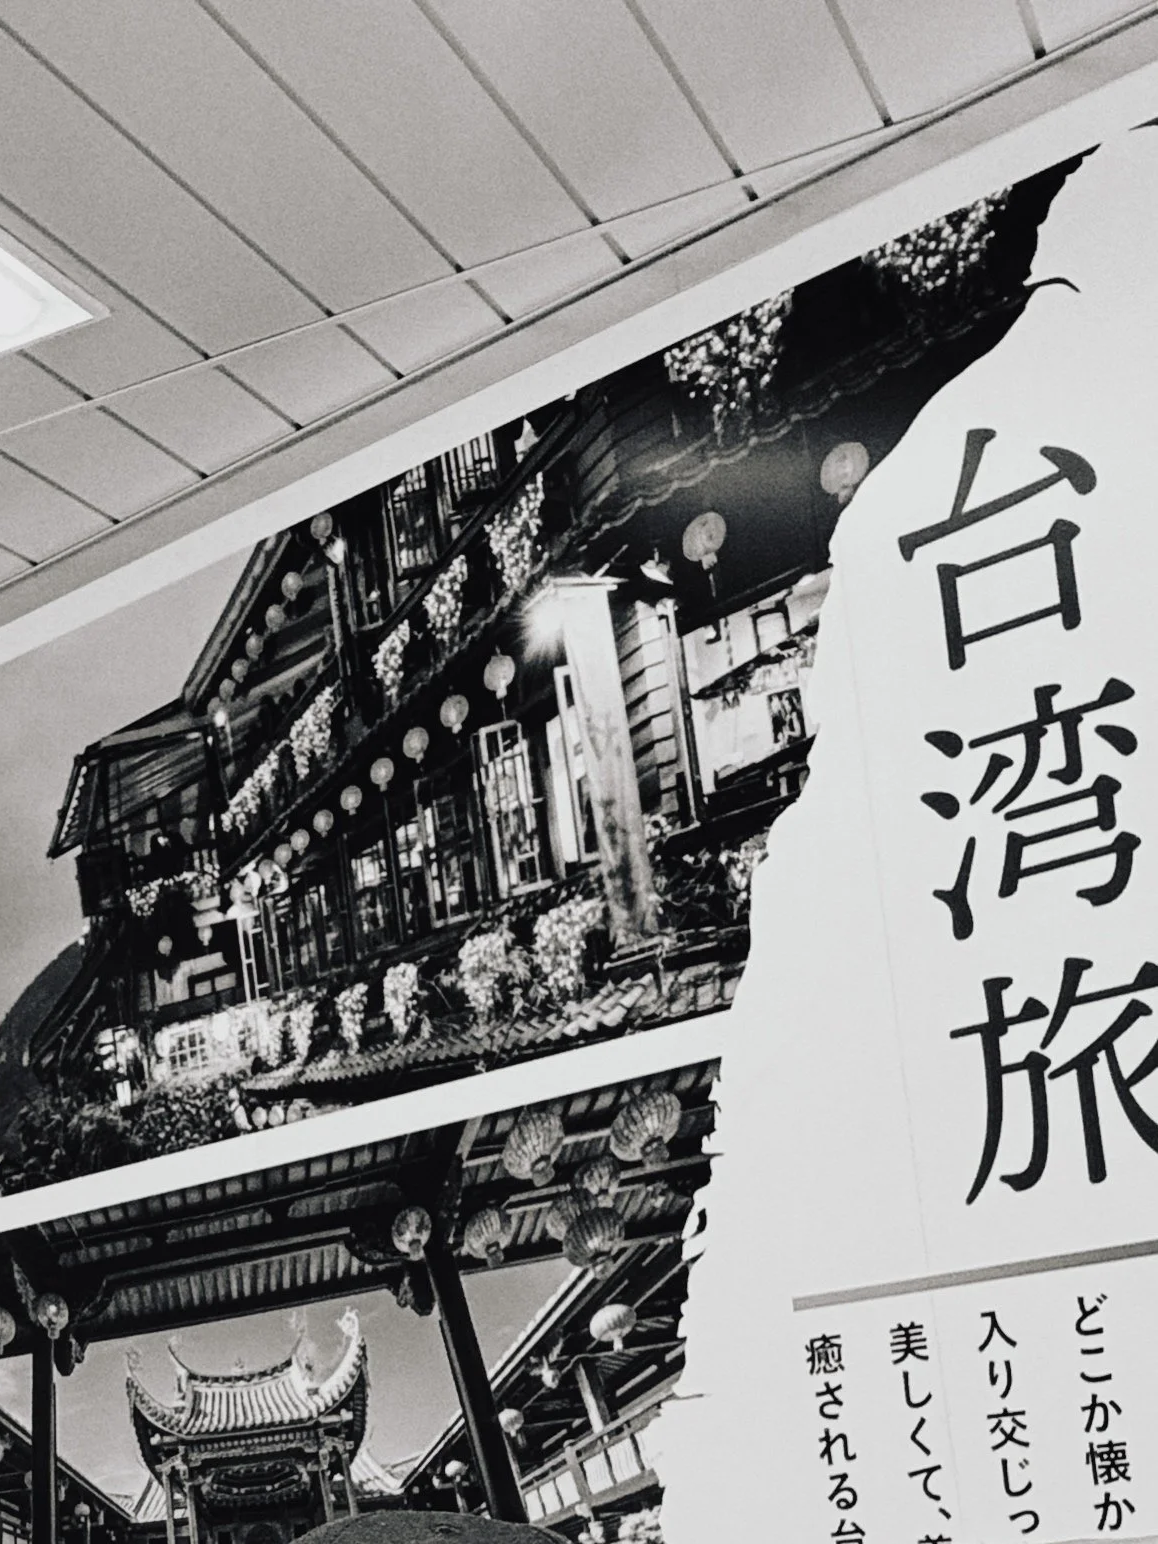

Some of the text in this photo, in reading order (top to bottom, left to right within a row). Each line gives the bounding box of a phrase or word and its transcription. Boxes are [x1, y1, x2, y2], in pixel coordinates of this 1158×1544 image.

[1075, 1292, 1136, 1531] どこか懐か
